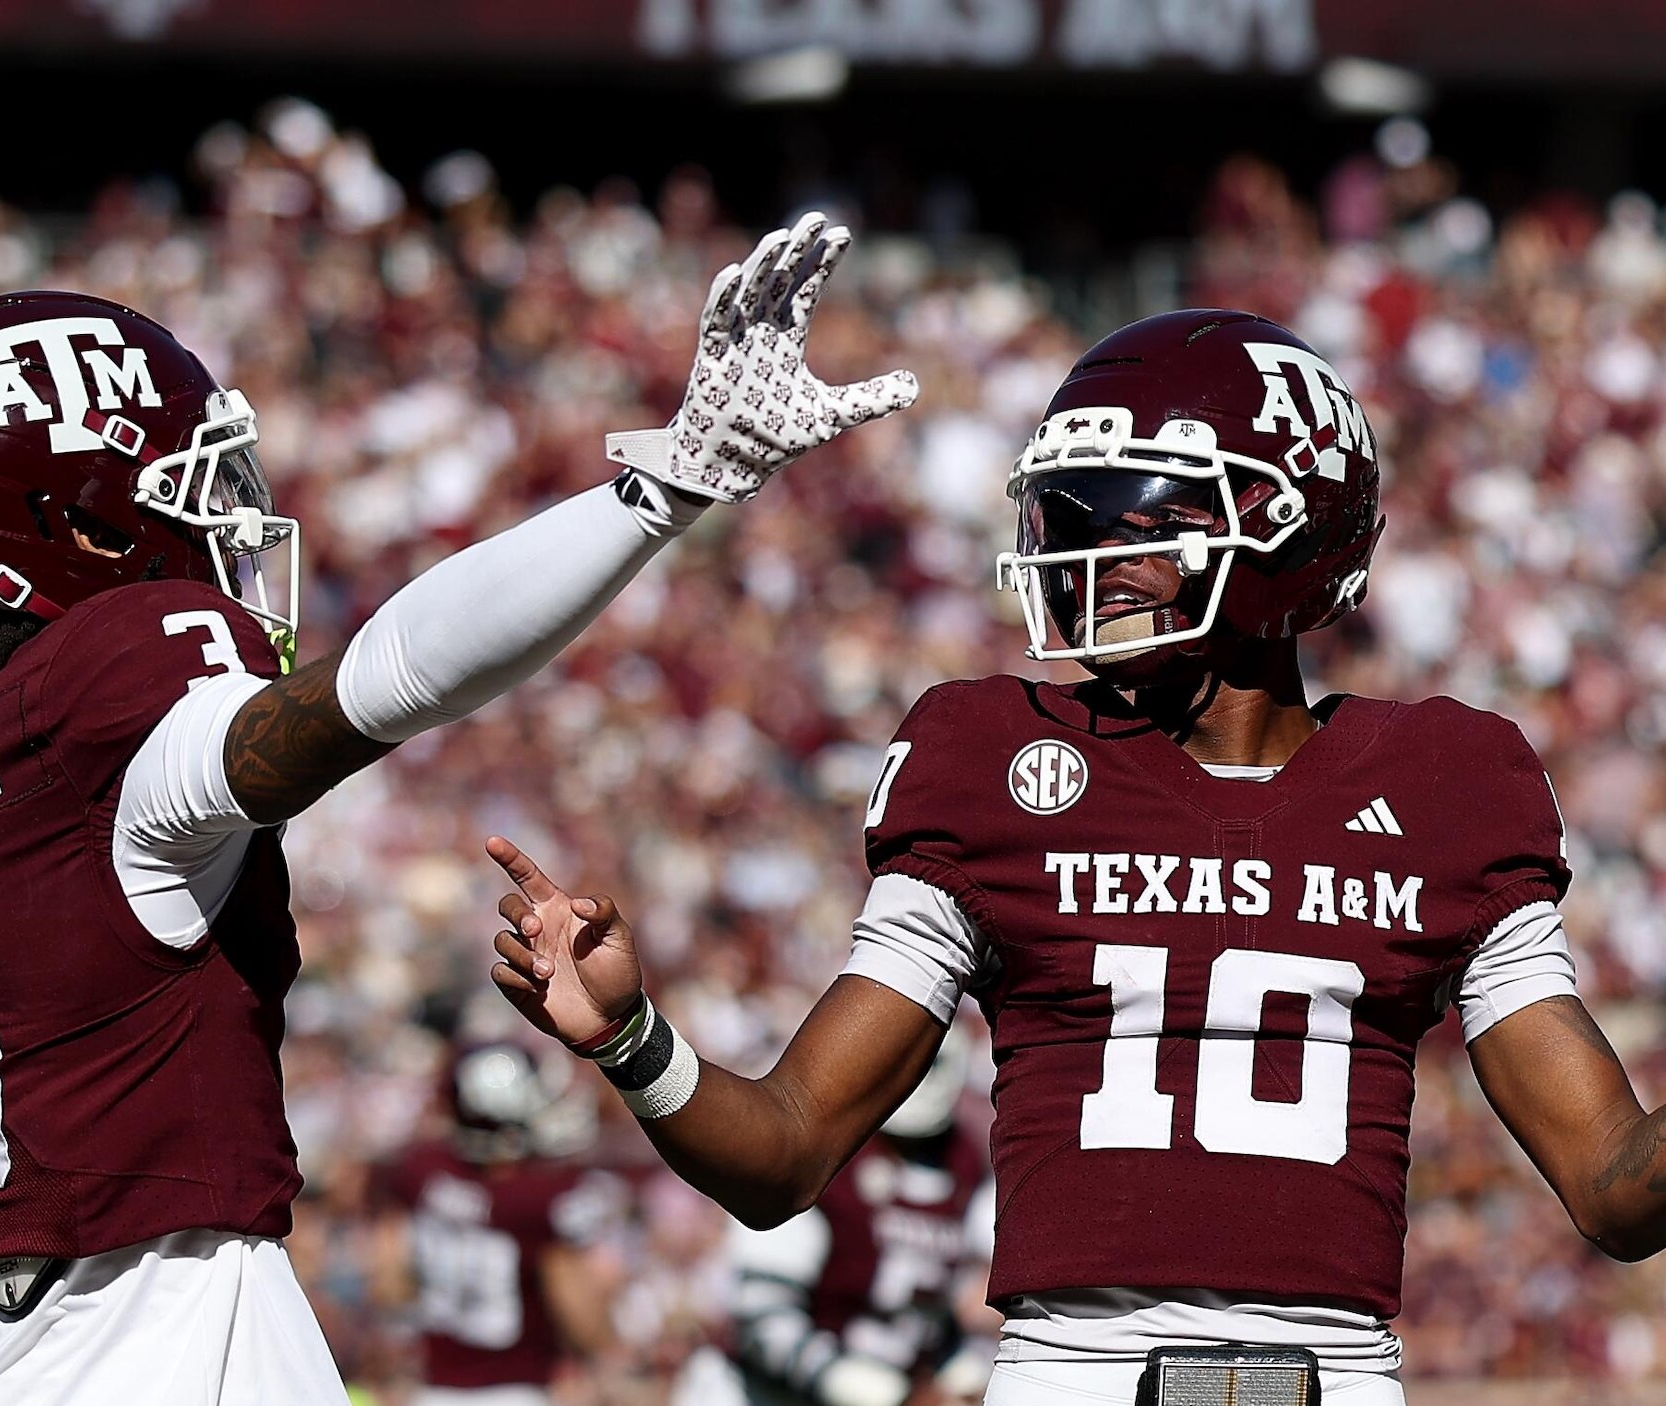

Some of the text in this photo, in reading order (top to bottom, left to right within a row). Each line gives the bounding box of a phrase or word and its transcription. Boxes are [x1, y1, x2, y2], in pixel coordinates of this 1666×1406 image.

[863, 740, 912, 831] 0
[1015, 745, 1082, 808] SEC
[1045, 851, 1425, 933] TEXAS A&M
[1079, 943, 1367, 1167] 10
